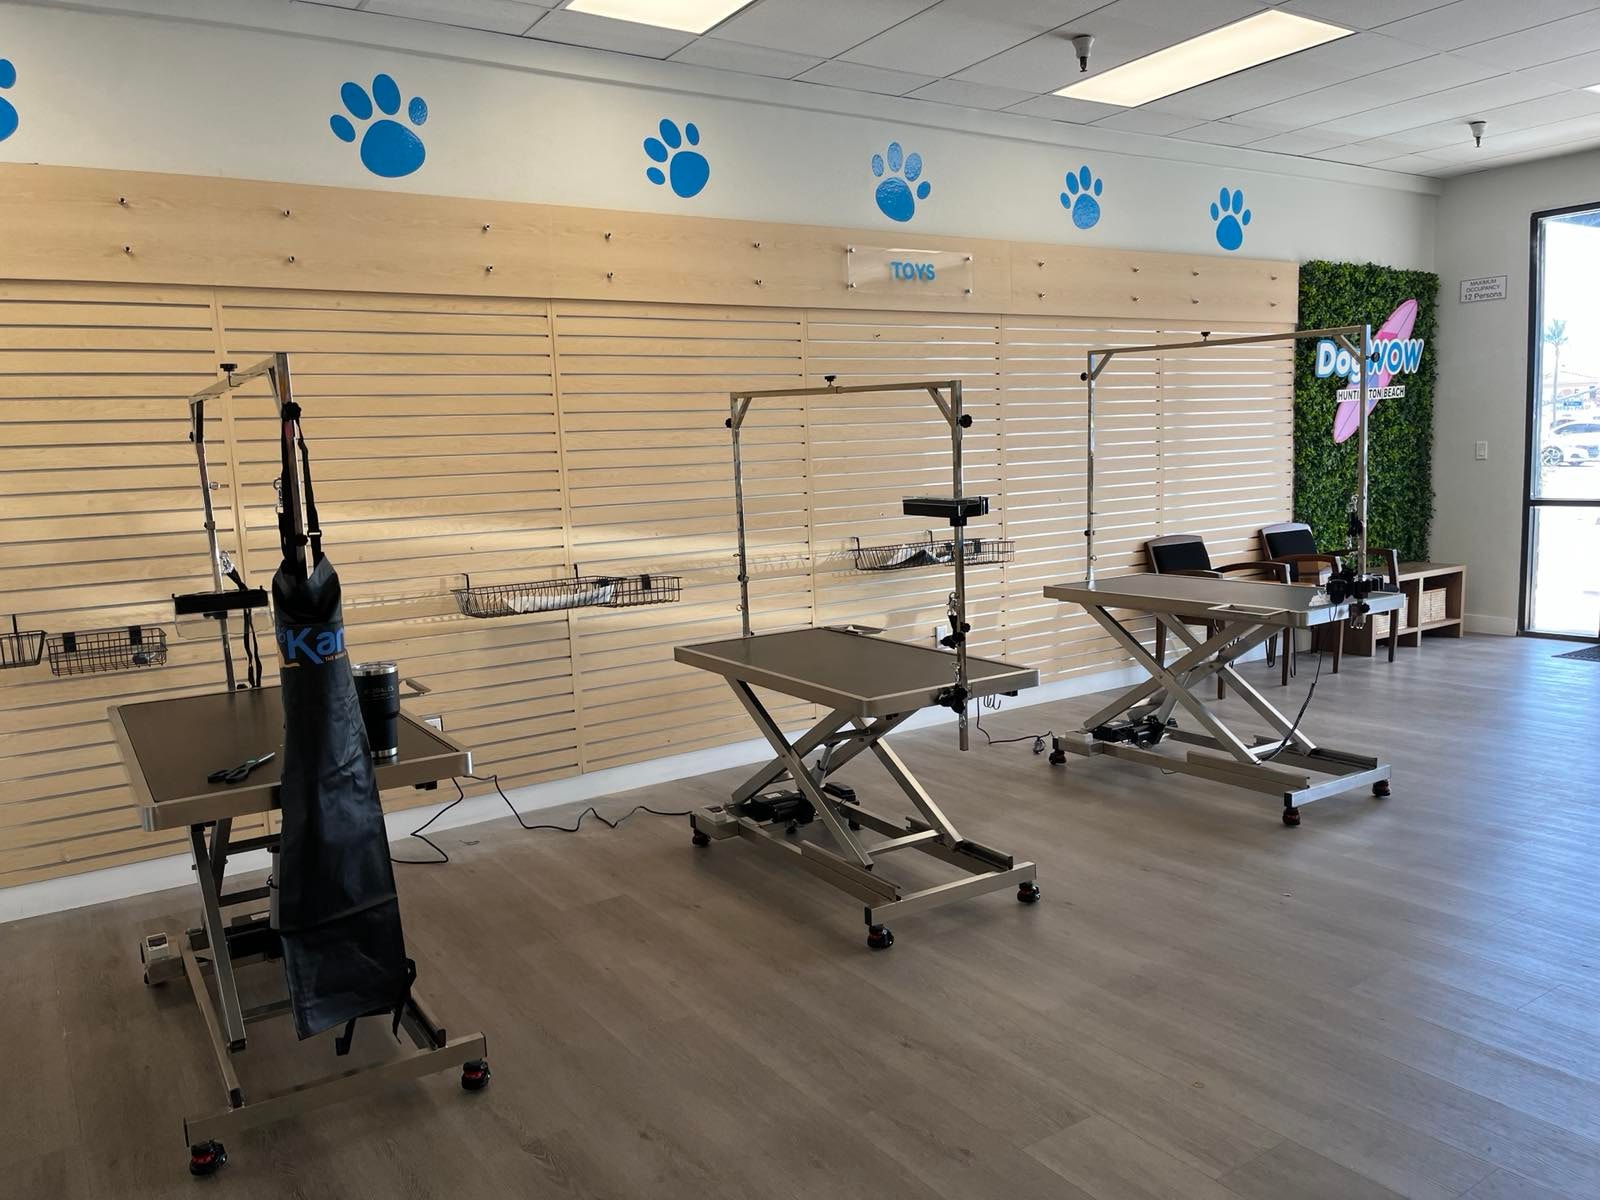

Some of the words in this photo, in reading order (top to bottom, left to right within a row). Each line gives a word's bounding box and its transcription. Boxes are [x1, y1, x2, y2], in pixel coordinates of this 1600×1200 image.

[890, 261, 936, 280] TOYS
[1469, 279, 1497, 287] MAXIMUM
[1465, 284, 1501, 293] OCCUPANCY
[1474, 291, 1503, 300] Persons
[1338, 389, 1382, 400] HUNTITON
[1383, 386, 1404, 398] BEACH
